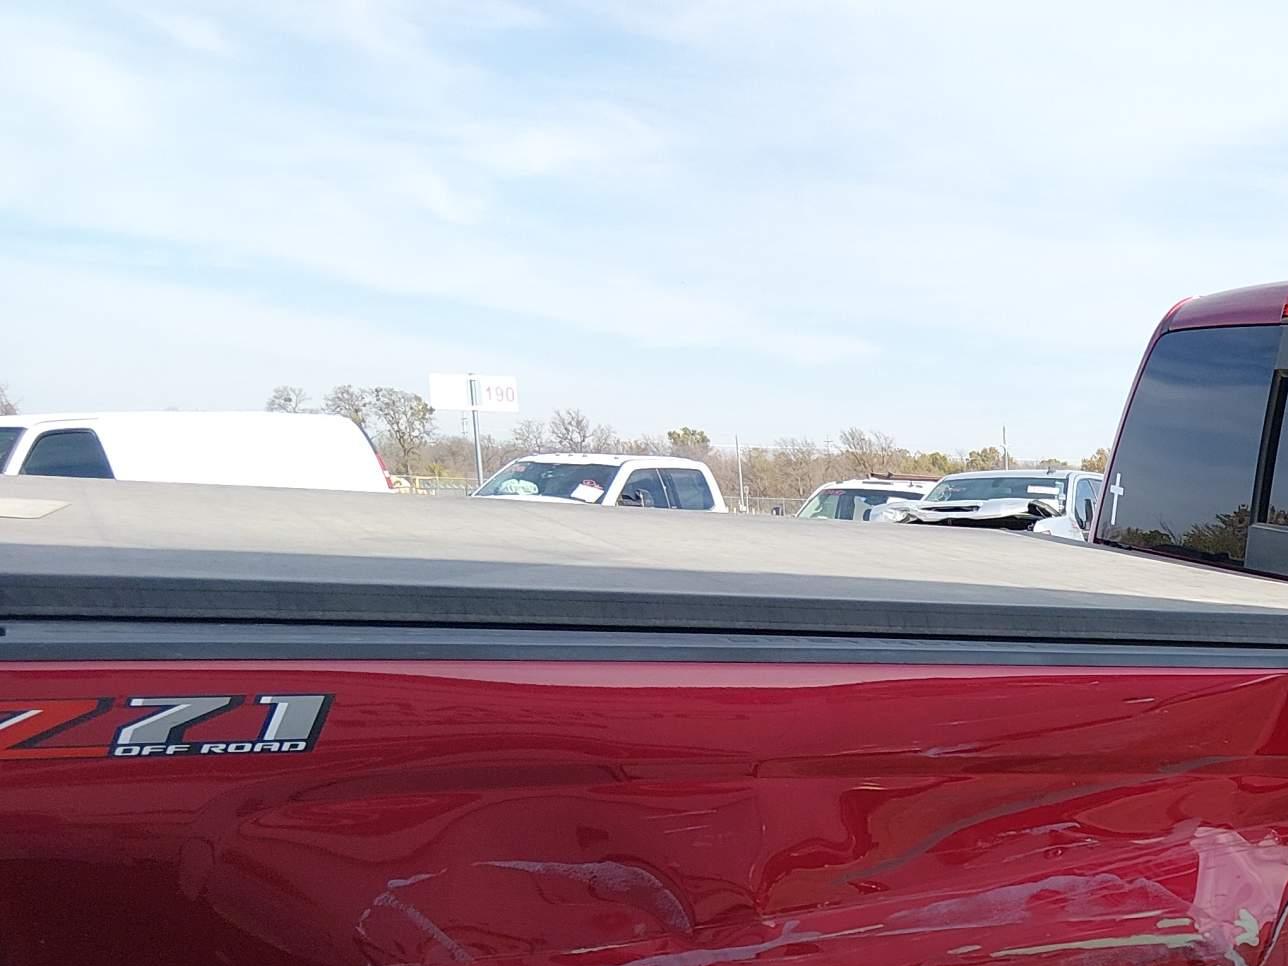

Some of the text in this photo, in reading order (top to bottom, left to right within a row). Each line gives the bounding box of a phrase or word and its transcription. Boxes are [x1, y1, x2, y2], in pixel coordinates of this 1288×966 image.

[487, 386, 515, 402] 190
[114, 740, 307, 757] OFF ROAD
